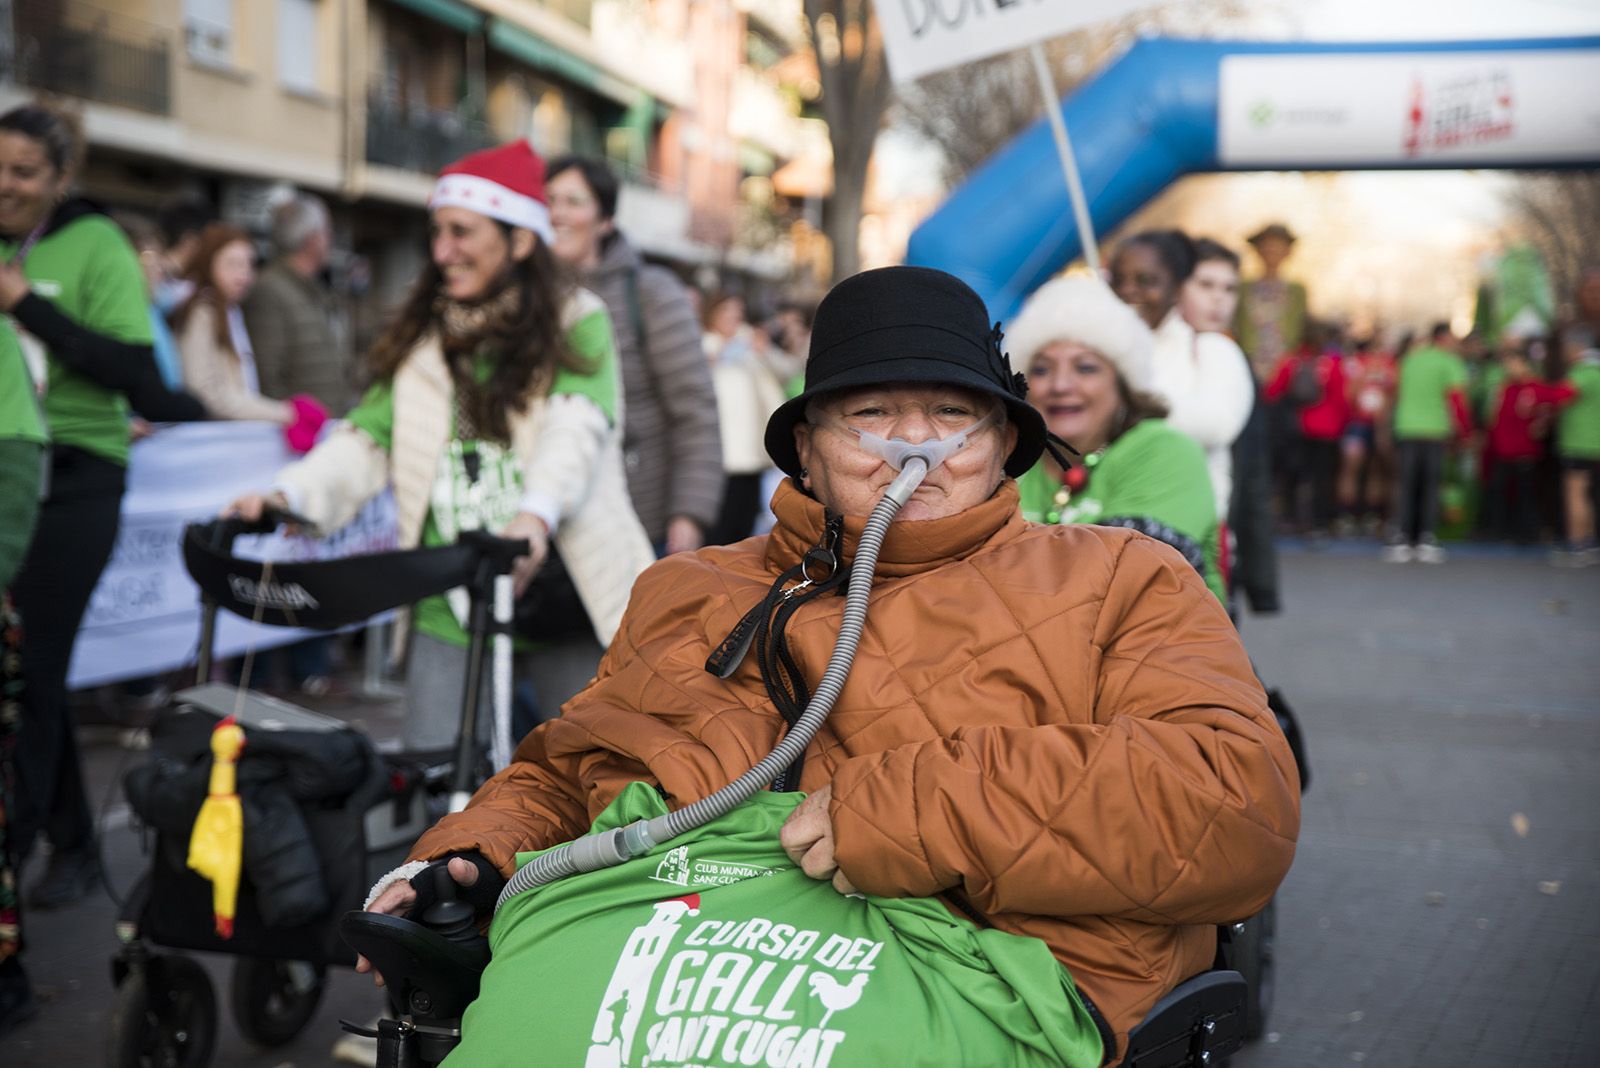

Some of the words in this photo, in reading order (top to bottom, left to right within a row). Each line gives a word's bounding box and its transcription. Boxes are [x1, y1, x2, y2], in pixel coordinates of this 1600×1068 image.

[693, 874, 717, 884] SANT
[694, 863, 719, 874] CLUB
[684, 918, 820, 961] CURSA
[813, 933, 885, 971] DEL
[655, 949, 809, 1020] GALL
[642, 1014, 730, 1068] SANT
[721, 1018, 846, 1068] CUGAT
